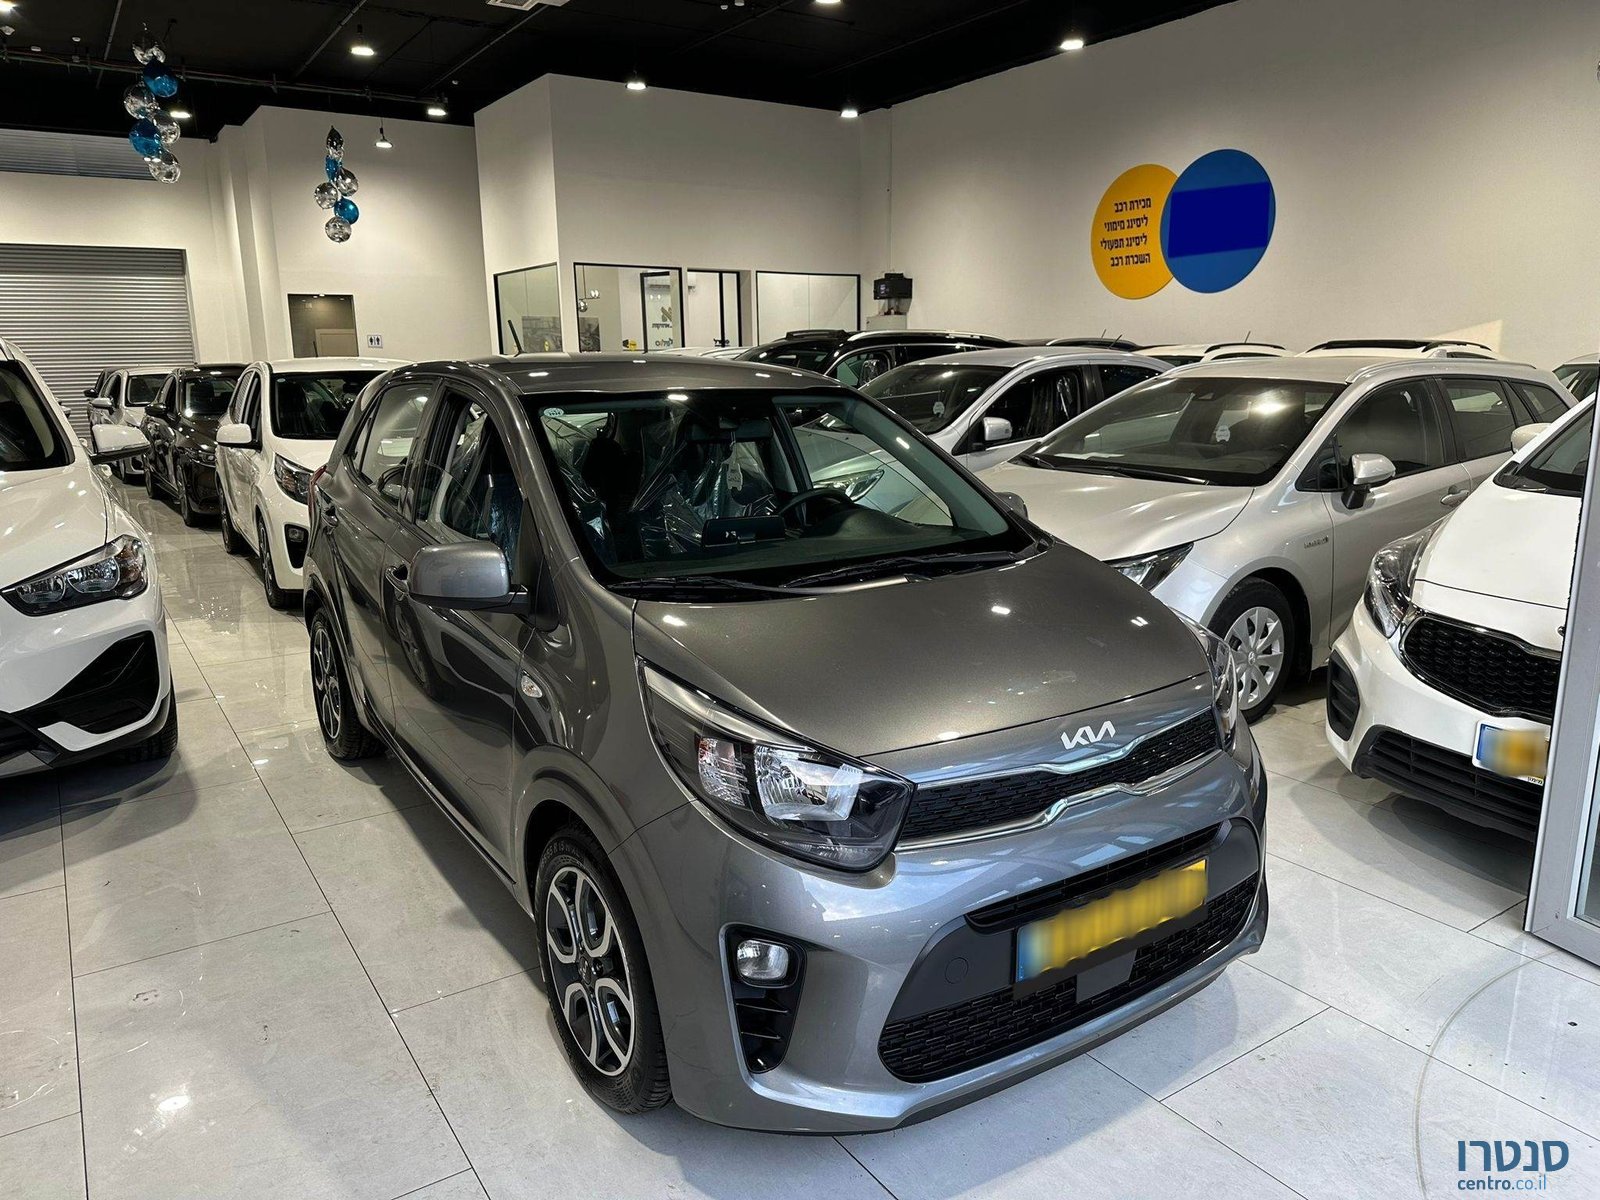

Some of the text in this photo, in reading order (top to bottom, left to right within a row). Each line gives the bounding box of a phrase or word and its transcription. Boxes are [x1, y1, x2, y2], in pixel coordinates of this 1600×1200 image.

[1114, 197, 1151, 213] מכירת רכב
[1104, 214, 1148, 232] ליסינג מימוני
[1100, 233, 1147, 251] ליסינג תפעולי
[1110, 253, 1151, 267] השכרת רכב
[1060, 720, 1116, 750] KIA
